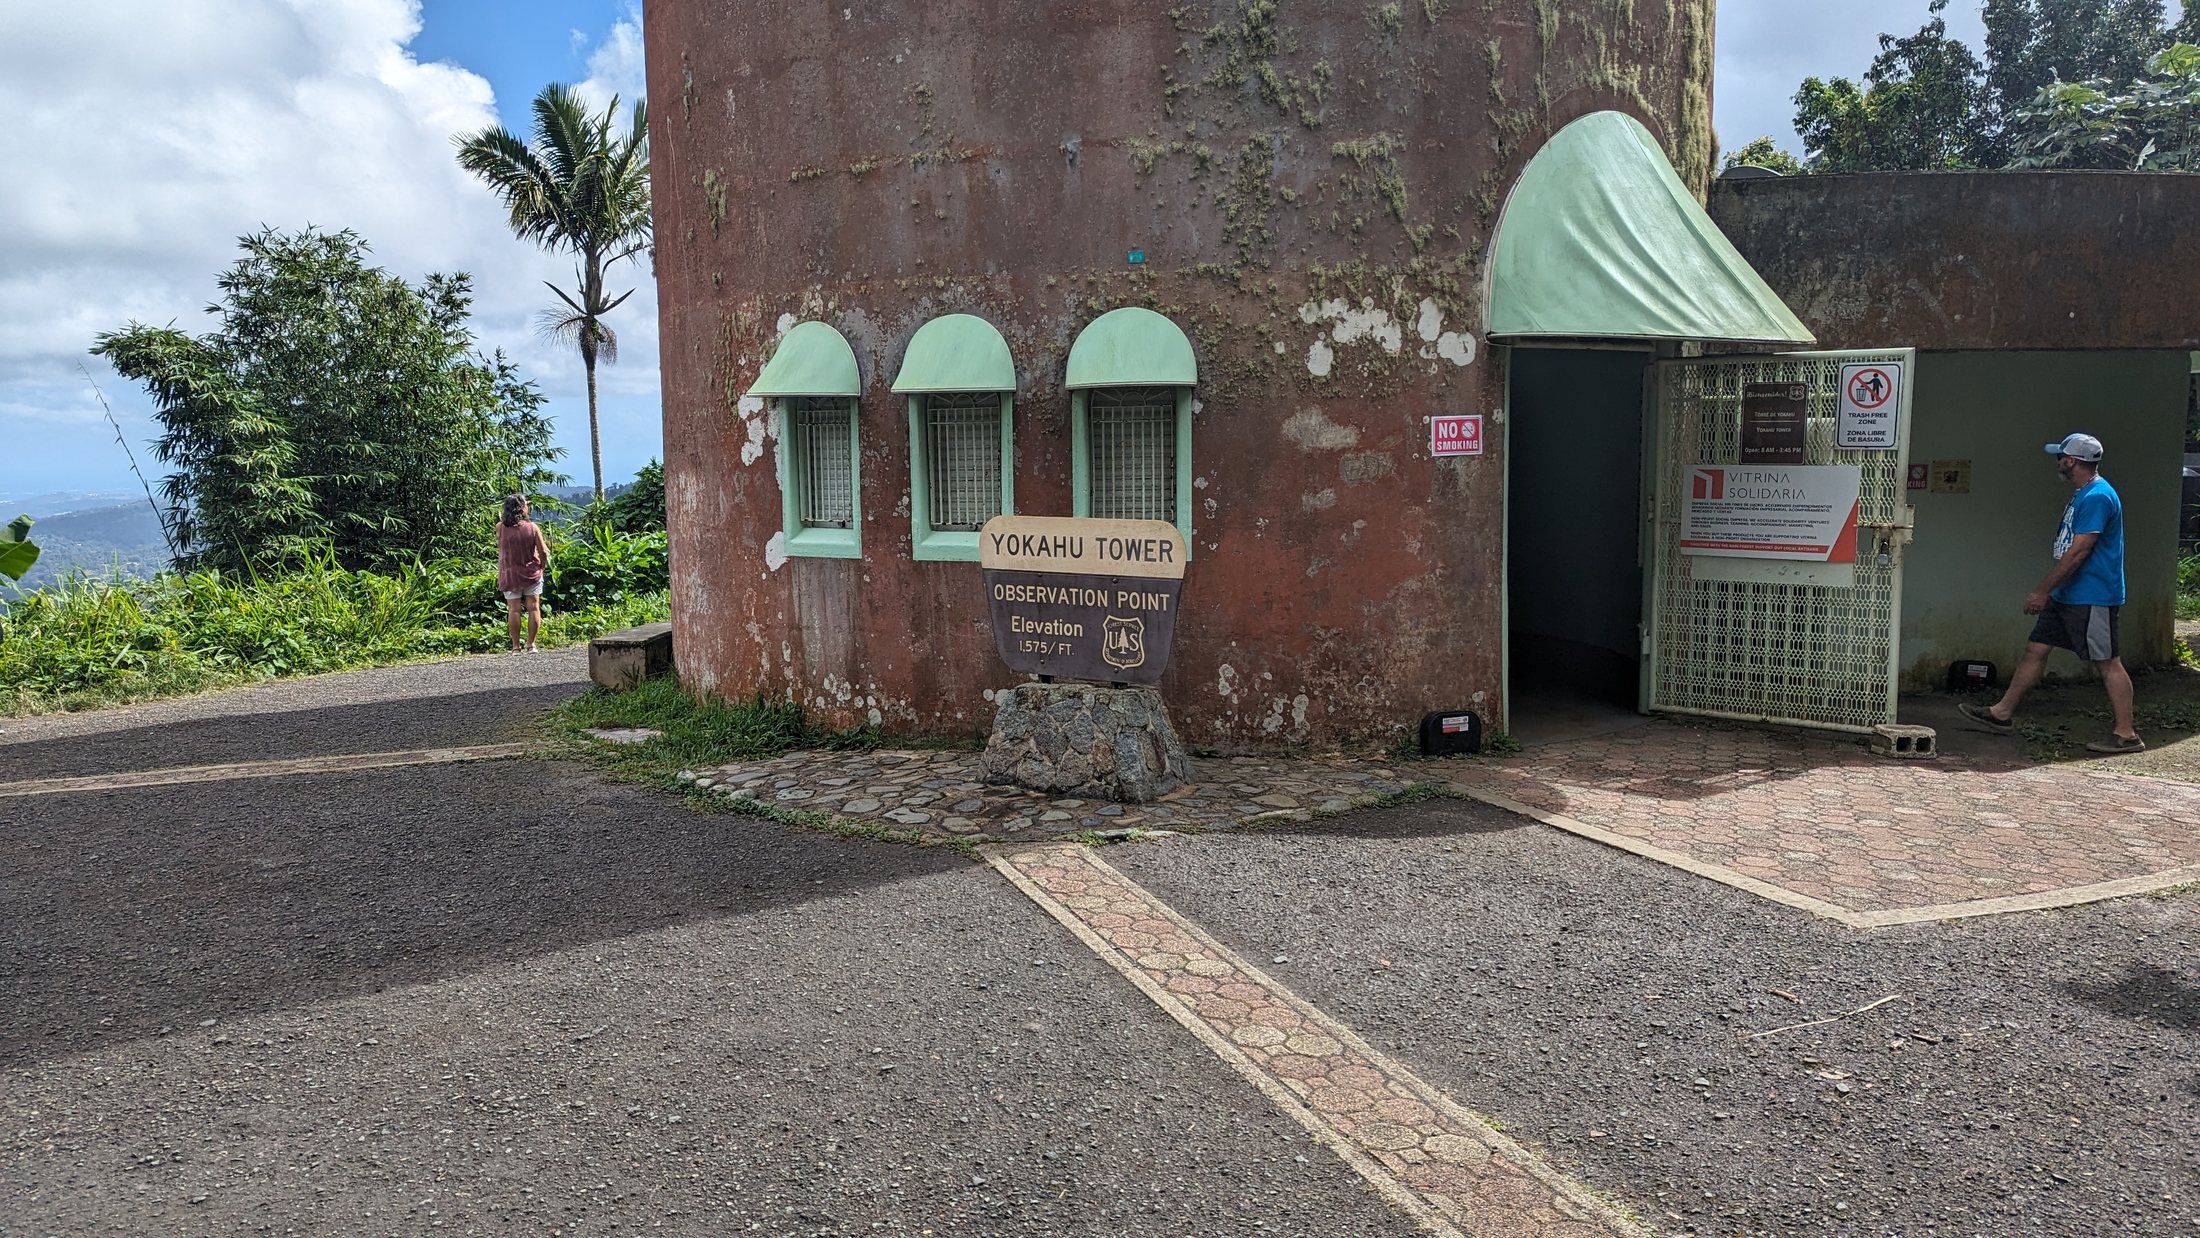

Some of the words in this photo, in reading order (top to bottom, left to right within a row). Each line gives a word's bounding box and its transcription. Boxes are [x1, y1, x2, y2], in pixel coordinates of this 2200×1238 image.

[1438, 422, 1458, 439] NO
[1436, 440, 1478, 451] SMOKING
[1729, 472, 1790, 483] VITRINA
[1908, 480, 1926, 488] KING
[1729, 487, 1806, 500] SOLIDARIA
[991, 533, 1084, 559] YOKAHU
[1095, 537, 1173, 563] TOWER
[994, 584, 1108, 608] OBSERVATION
[1117, 591, 1170, 611] POINT
[1011, 615, 1083, 637] Elevation
[1058, 643, 1075, 656] FT.
